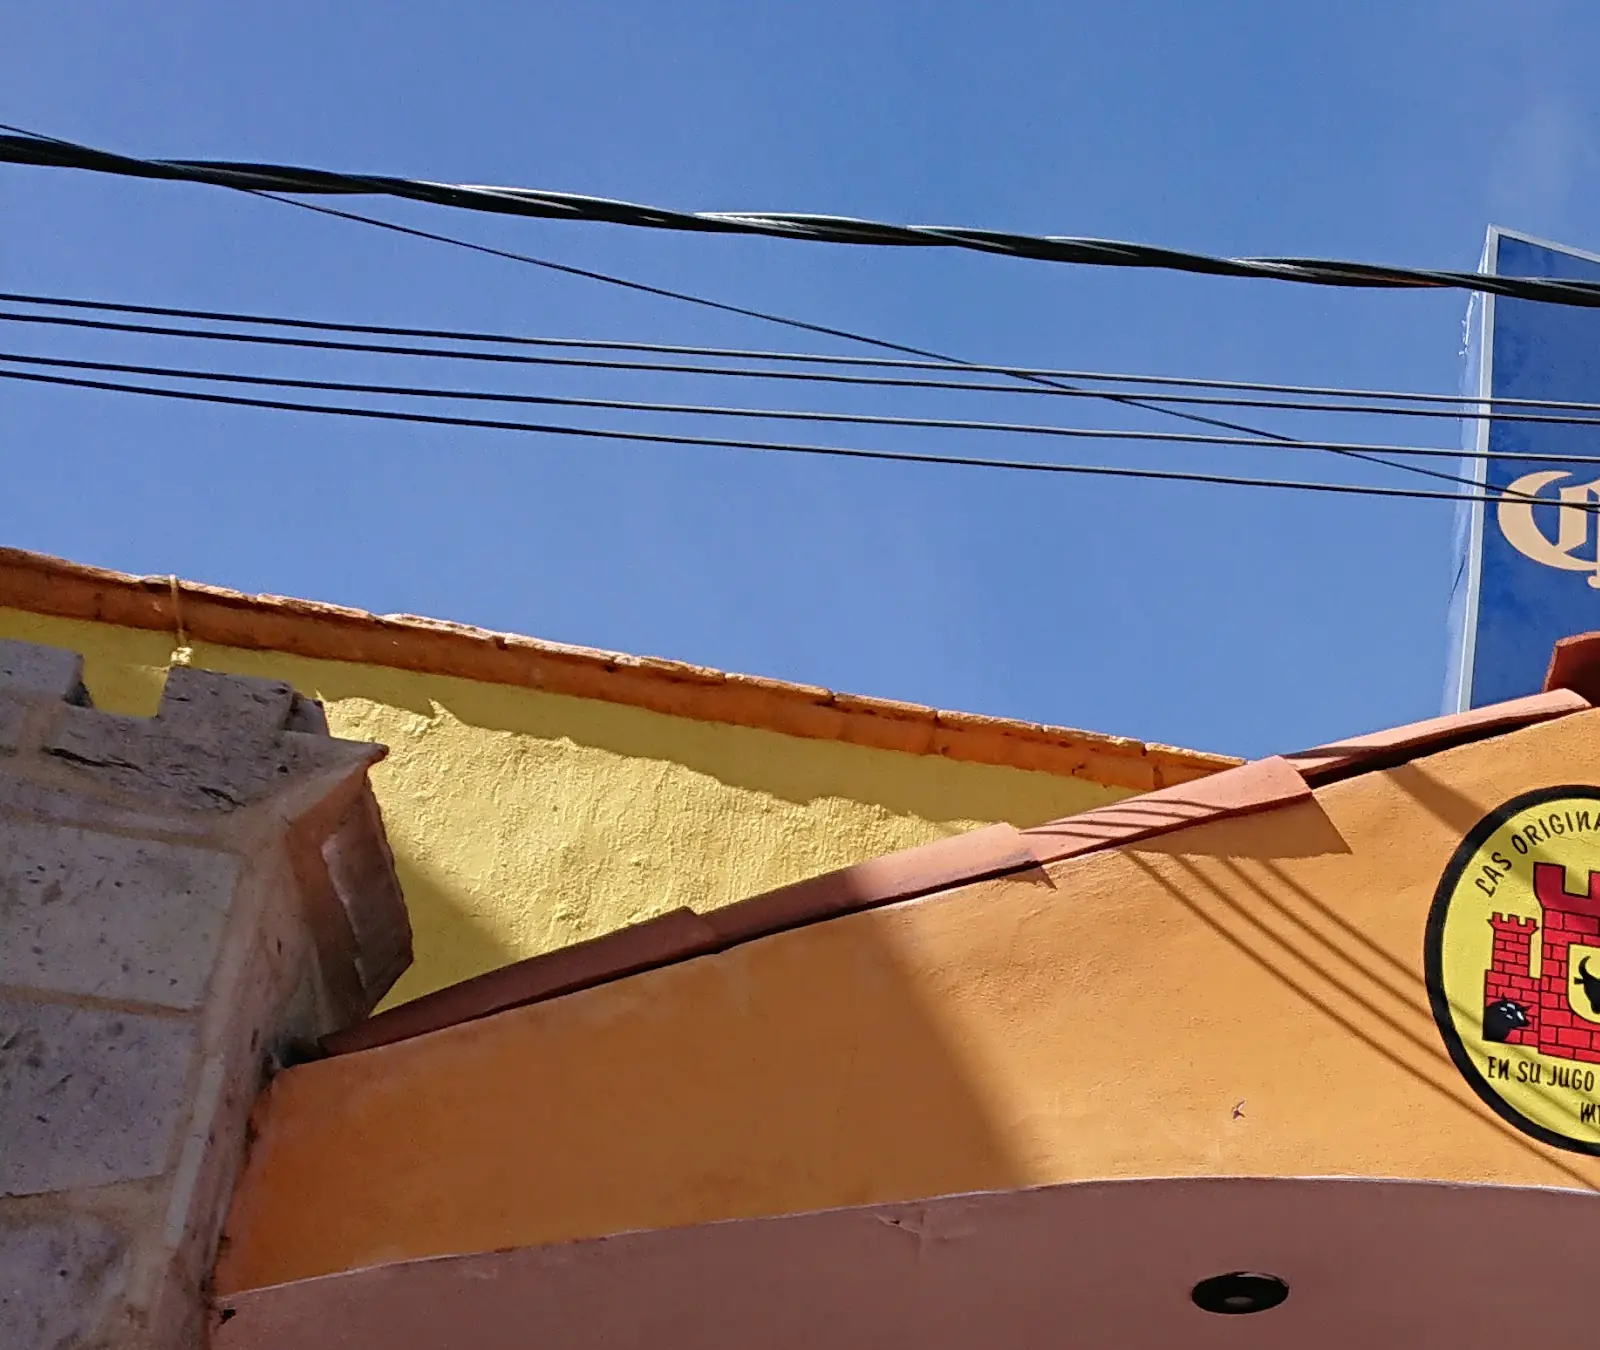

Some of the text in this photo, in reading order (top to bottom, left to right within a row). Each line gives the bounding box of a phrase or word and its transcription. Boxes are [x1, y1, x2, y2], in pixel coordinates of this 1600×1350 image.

[1475, 850, 1513, 899] LAS
[1486, 1055, 1511, 1081] EN
[1517, 1061, 1542, 1085] SU
[1546, 1068, 1595, 1093] JUGO
